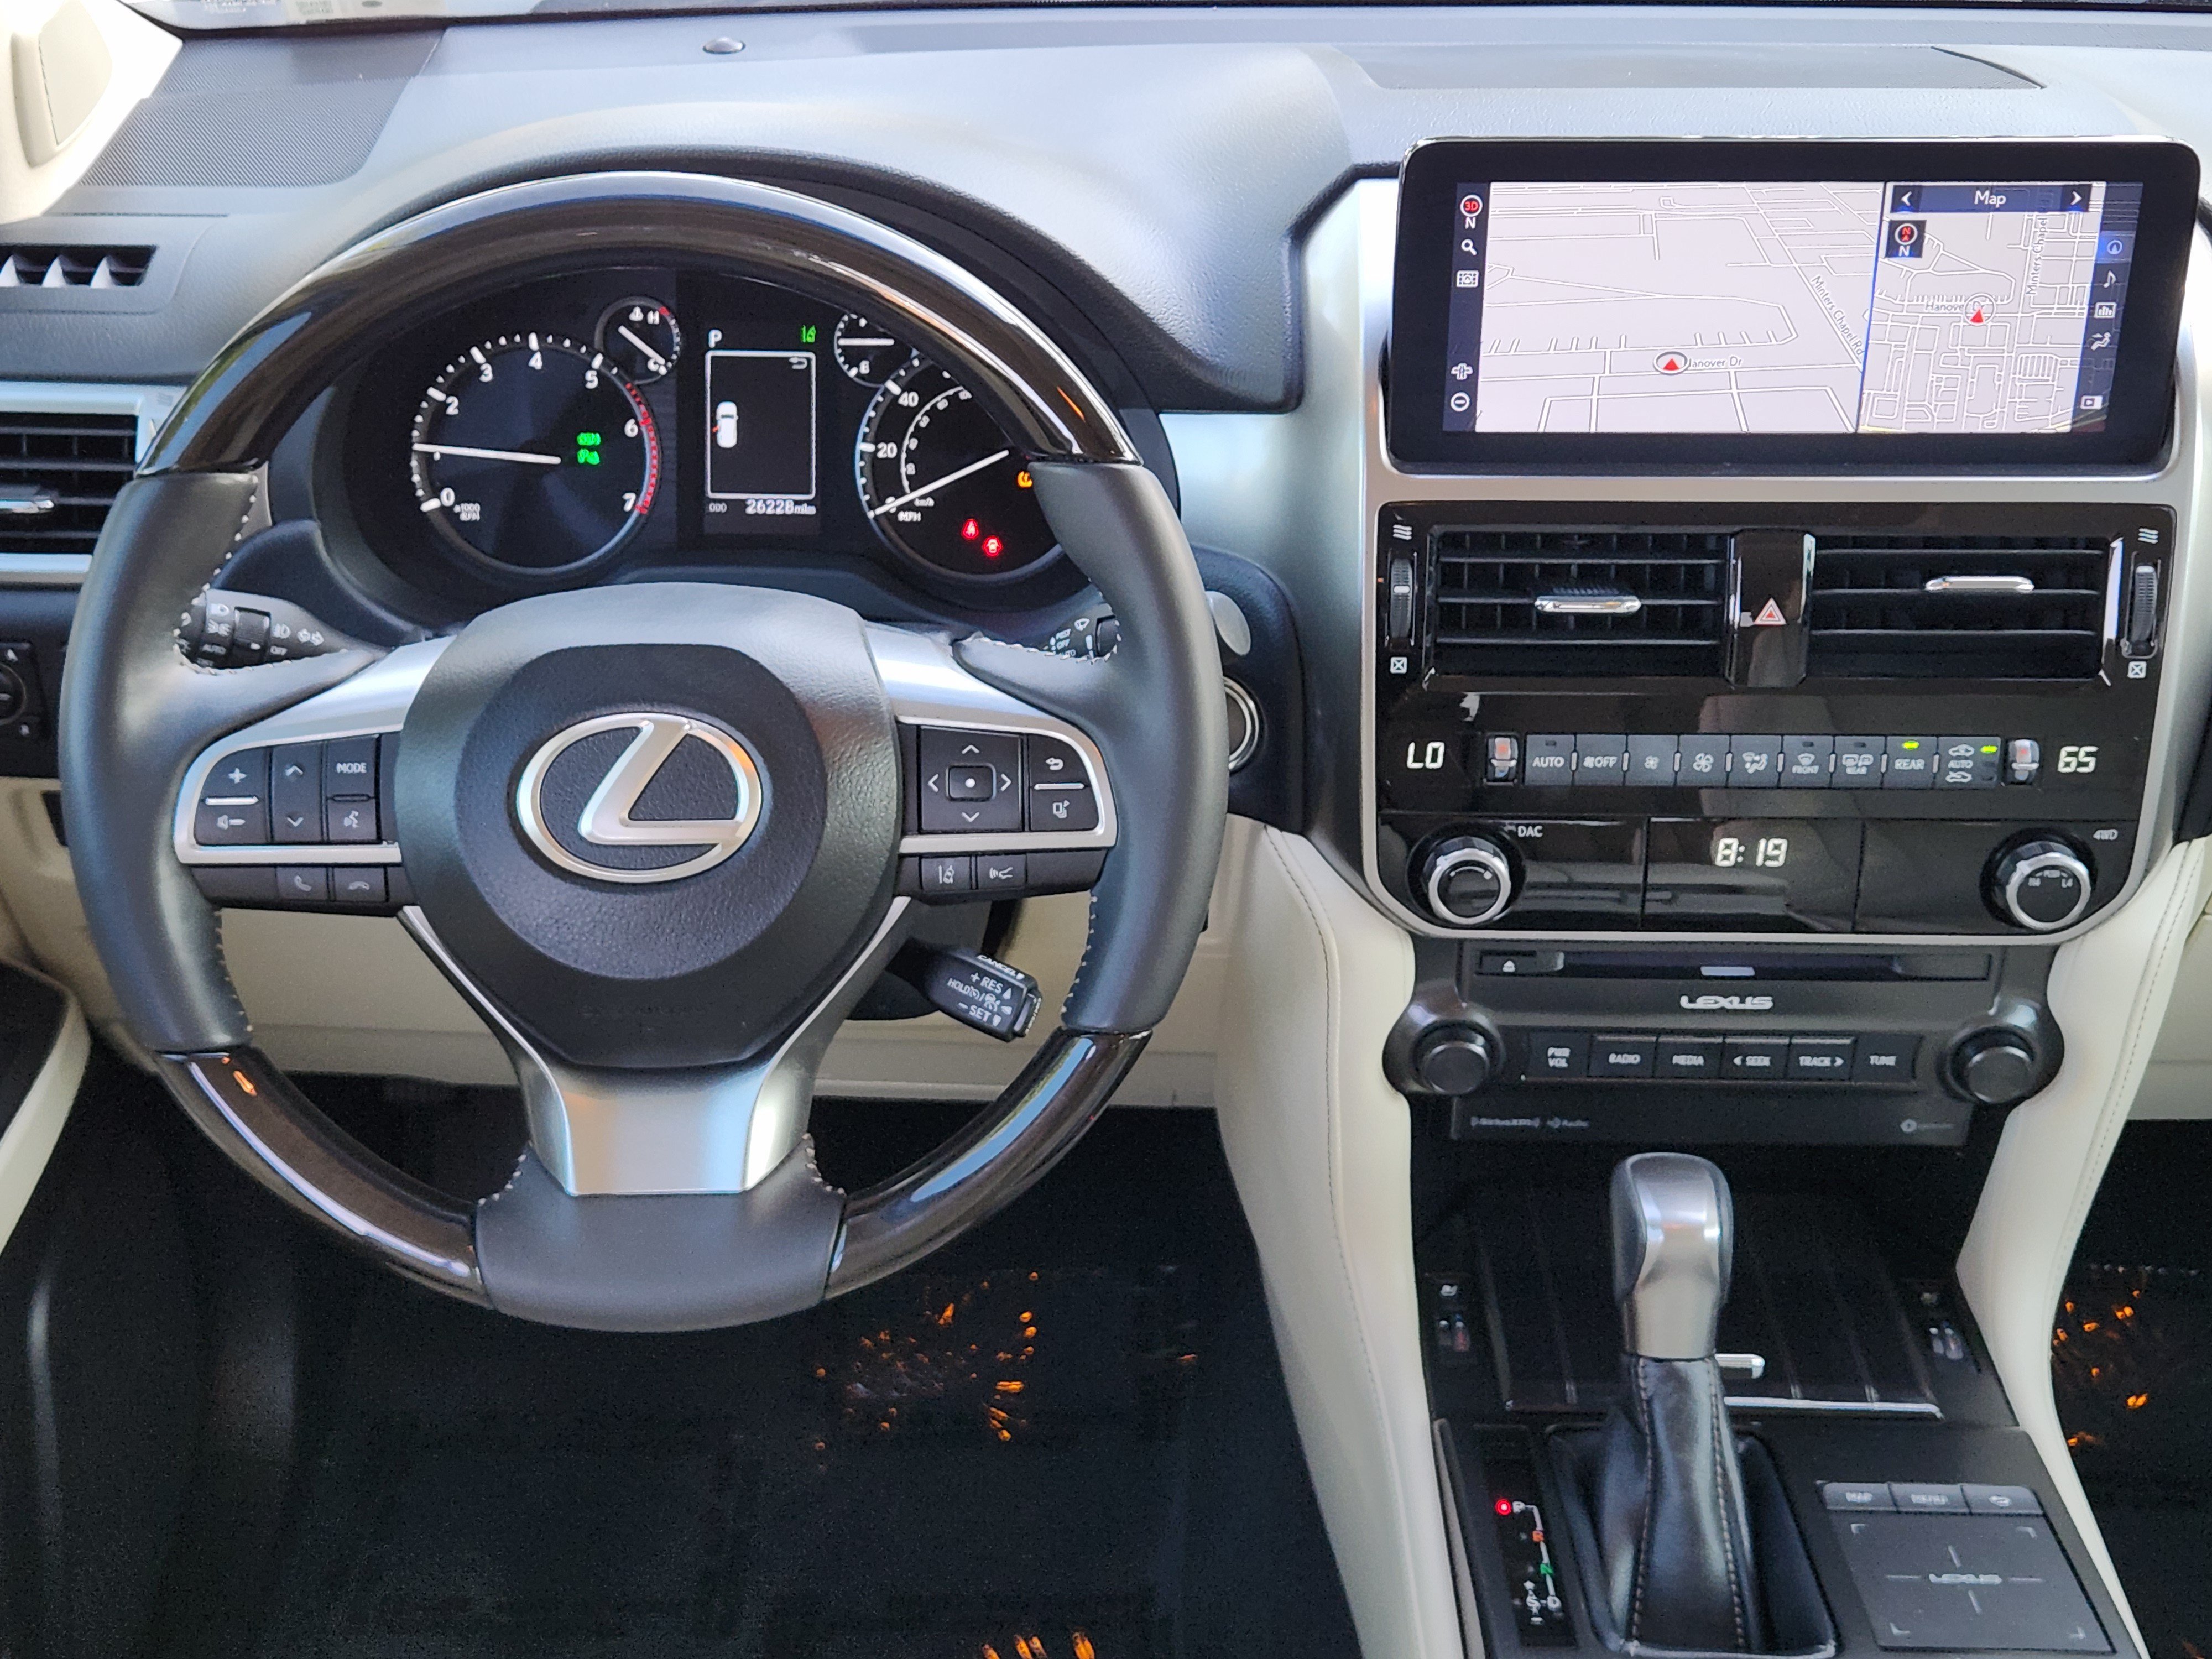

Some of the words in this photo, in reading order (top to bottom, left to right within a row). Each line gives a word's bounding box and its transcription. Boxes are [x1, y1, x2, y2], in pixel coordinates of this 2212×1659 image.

[1465, 201, 1479, 211] 3D
[1974, 190, 2007, 208] Map
[1465, 217, 1476, 229] N
[2032, 217, 2048, 253] Chapel
[1898, 245, 1910, 257] N
[2026, 256, 2042, 295] Minters
[1926, 300, 1964, 311] Hanove
[1812, 275, 1835, 311] Minters
[1833, 310, 1858, 342] Chapel
[1851, 340, 1864, 356] Rd
[708, 329, 722, 348] P
[529, 352, 543, 370] 4
[1730, 356, 1742, 366] Dr
[480, 363, 493, 382] 3
[585, 370, 599, 389] 5
[446, 396, 459, 415] 2
[898, 391, 919, 407] 40
[624, 419, 639, 437] 6
[877, 442, 898, 458] 20
[440, 487, 455, 507] 0
[623, 492, 637, 512] 7
[745, 499, 794, 515] 26228
[1532, 757, 1564, 768] AUTO
[1594, 756, 1618, 768] OFF
[1895, 759, 1924, 770] REAR
[1948, 759, 1973, 769] AUTO
[2058, 745, 2099, 773] 65
[336, 762, 367, 774] MODE
[1517, 826, 1543, 837] DAC
[1715, 838, 1788, 867] 8:19
[1680, 995, 1773, 1009] LEXUS
